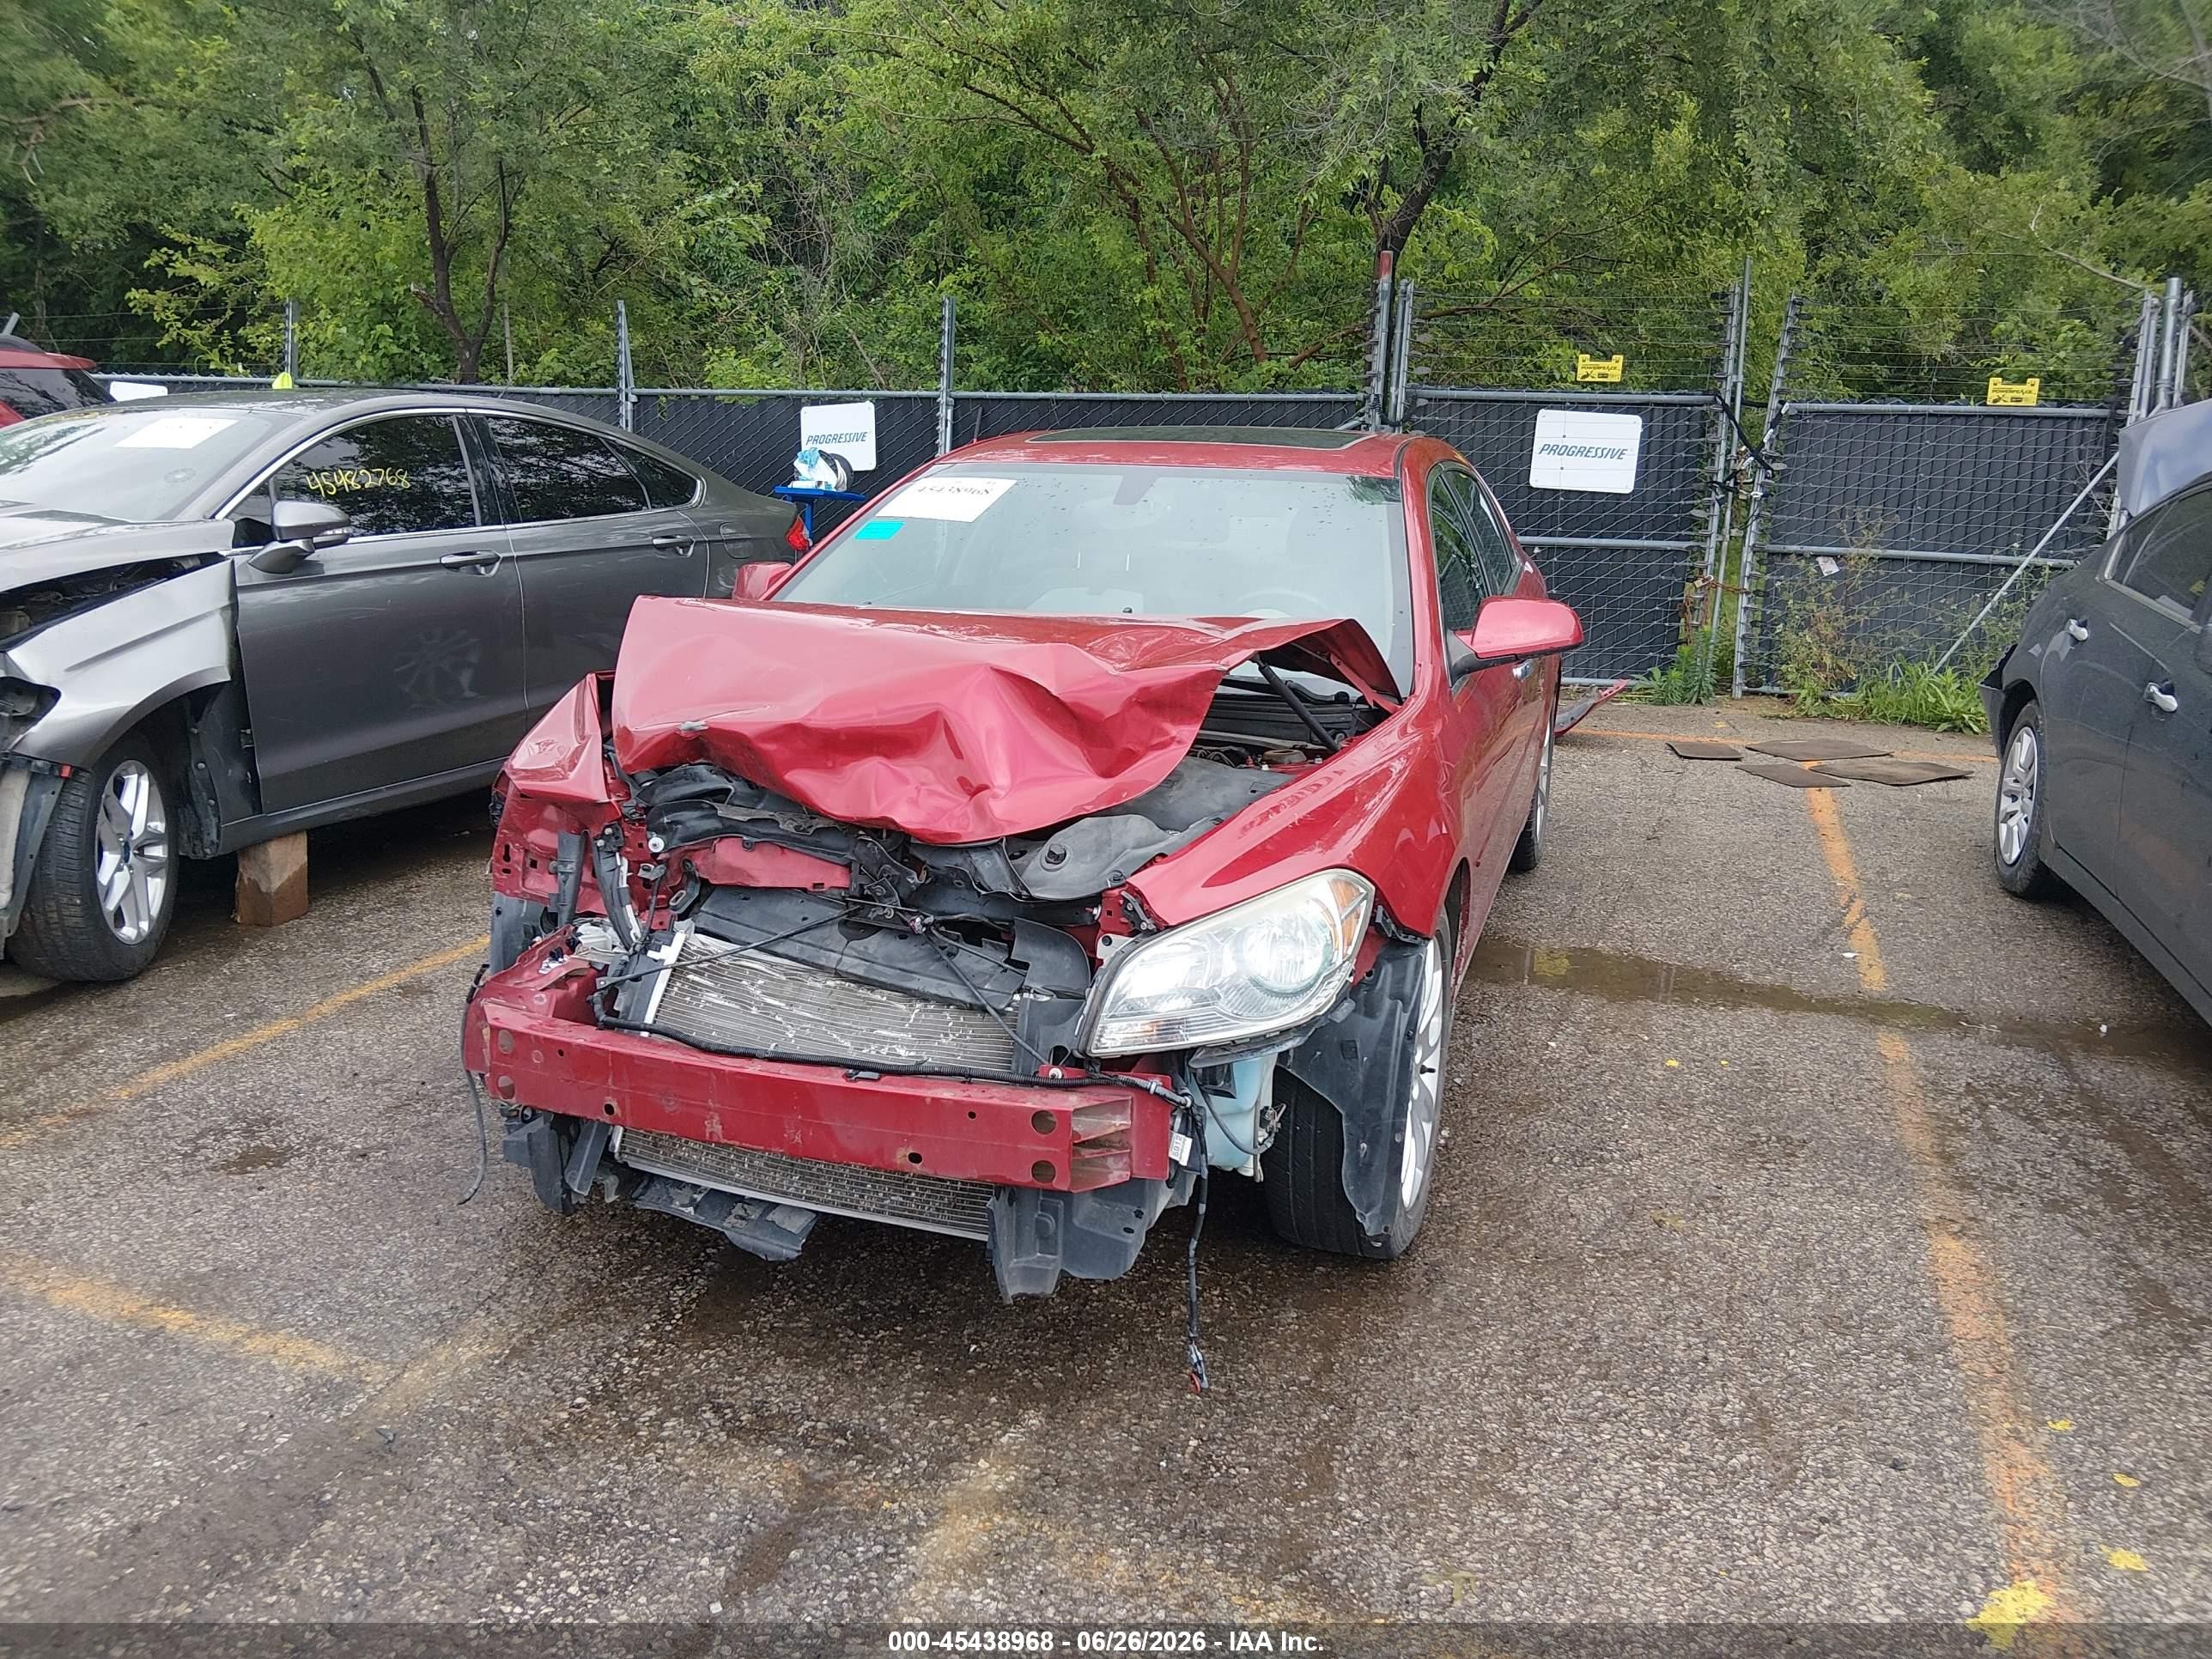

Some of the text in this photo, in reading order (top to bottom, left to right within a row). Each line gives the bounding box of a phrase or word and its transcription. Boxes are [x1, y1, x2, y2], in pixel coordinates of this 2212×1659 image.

[805, 431, 868, 446] PROGRESSIVE
[1539, 443, 1628, 460] PROGRESSIVE
[306, 467, 410, 497] 45482768
